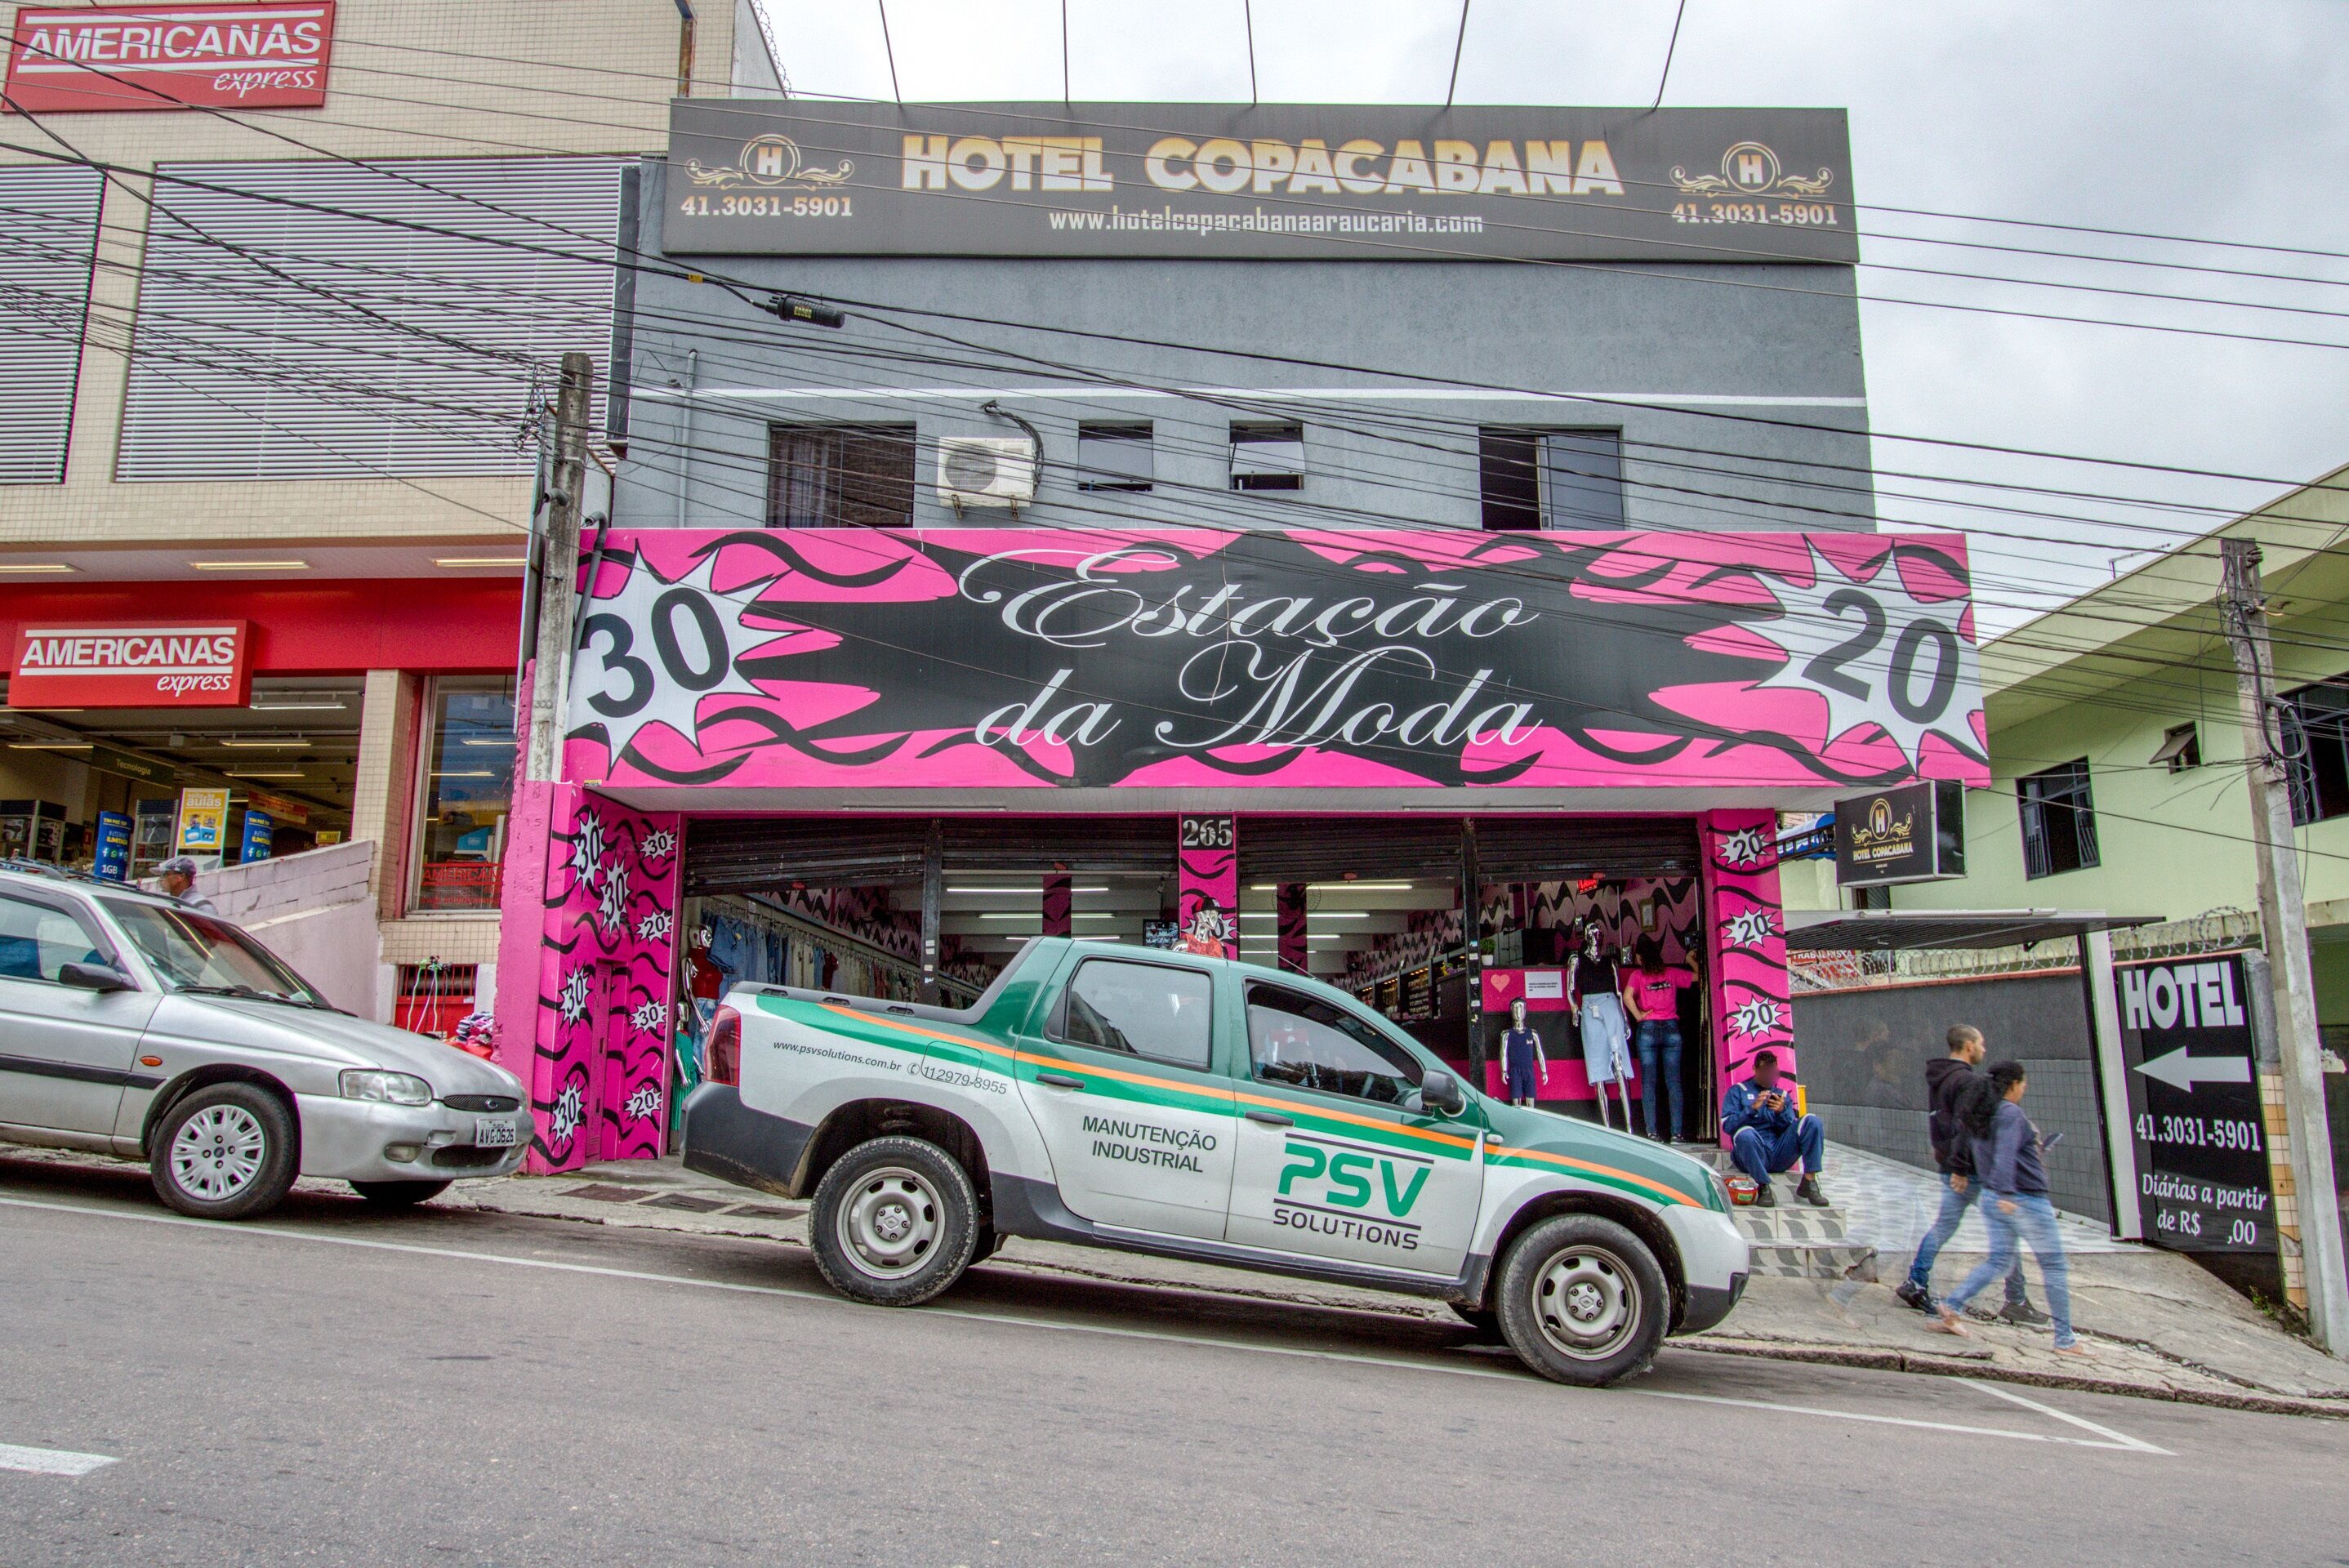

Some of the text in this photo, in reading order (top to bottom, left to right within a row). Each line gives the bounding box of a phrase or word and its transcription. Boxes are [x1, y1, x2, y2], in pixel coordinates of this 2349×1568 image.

[21, 21, 322, 61] AMERICANAS
[213, 69, 318, 99] express
[902, 135, 1625, 196] HOTEL COPACABANA
[680, 195, 853, 217] 41.3031-5901
[1050, 205, 1483, 237] www.hotelcopacabanaaraucaria.com
[1671, 203, 1838, 225] 41.3031-5901
[958, 549, 1540, 647] Estação
[21, 637, 235, 666] AMERICANAS
[573, 586, 731, 719] 30
[1800, 588, 1959, 724] 20
[157, 675, 233, 697] express
[974, 639, 1544, 748] da Moda
[186, 796, 222, 807] aulas
[647, 835, 668, 855] 30
[1182, 819, 1233, 847] 265
[1732, 832, 1763, 862] 20
[576, 825, 601, 875] 30
[1852, 842, 1914, 862] HOTEL COPACABANA
[101, 864, 118, 875] 1GB
[604, 871, 626, 921] 30
[644, 915, 666, 938] 20
[1738, 913, 1769, 942] 20
[566, 974, 585, 1014] 30
[2122, 961, 2244, 1030] HOTEL
[639, 1005, 659, 1027] 30
[1741, 1002, 1773, 1032] 20
[773, 1041, 903, 1072] www.psvsolutions.com.br
[557, 1094, 577, 1134] 30
[634, 1091, 655, 1114] 20
[1082, 1115, 1217, 1151] MANUTENÇÃO
[2135, 1113, 2262, 1152] 41.3031-5901
[1092, 1140, 1204, 1174] INDUSTRIAL
[1277, 1141, 1432, 1218] PSV
[2142, 1173, 2267, 1212] Diárias a partir
[1273, 1208, 1420, 1250] SOLUTIONS
[2156, 1208, 2176, 1232] de
[2179, 1209, 2201, 1236] R$
